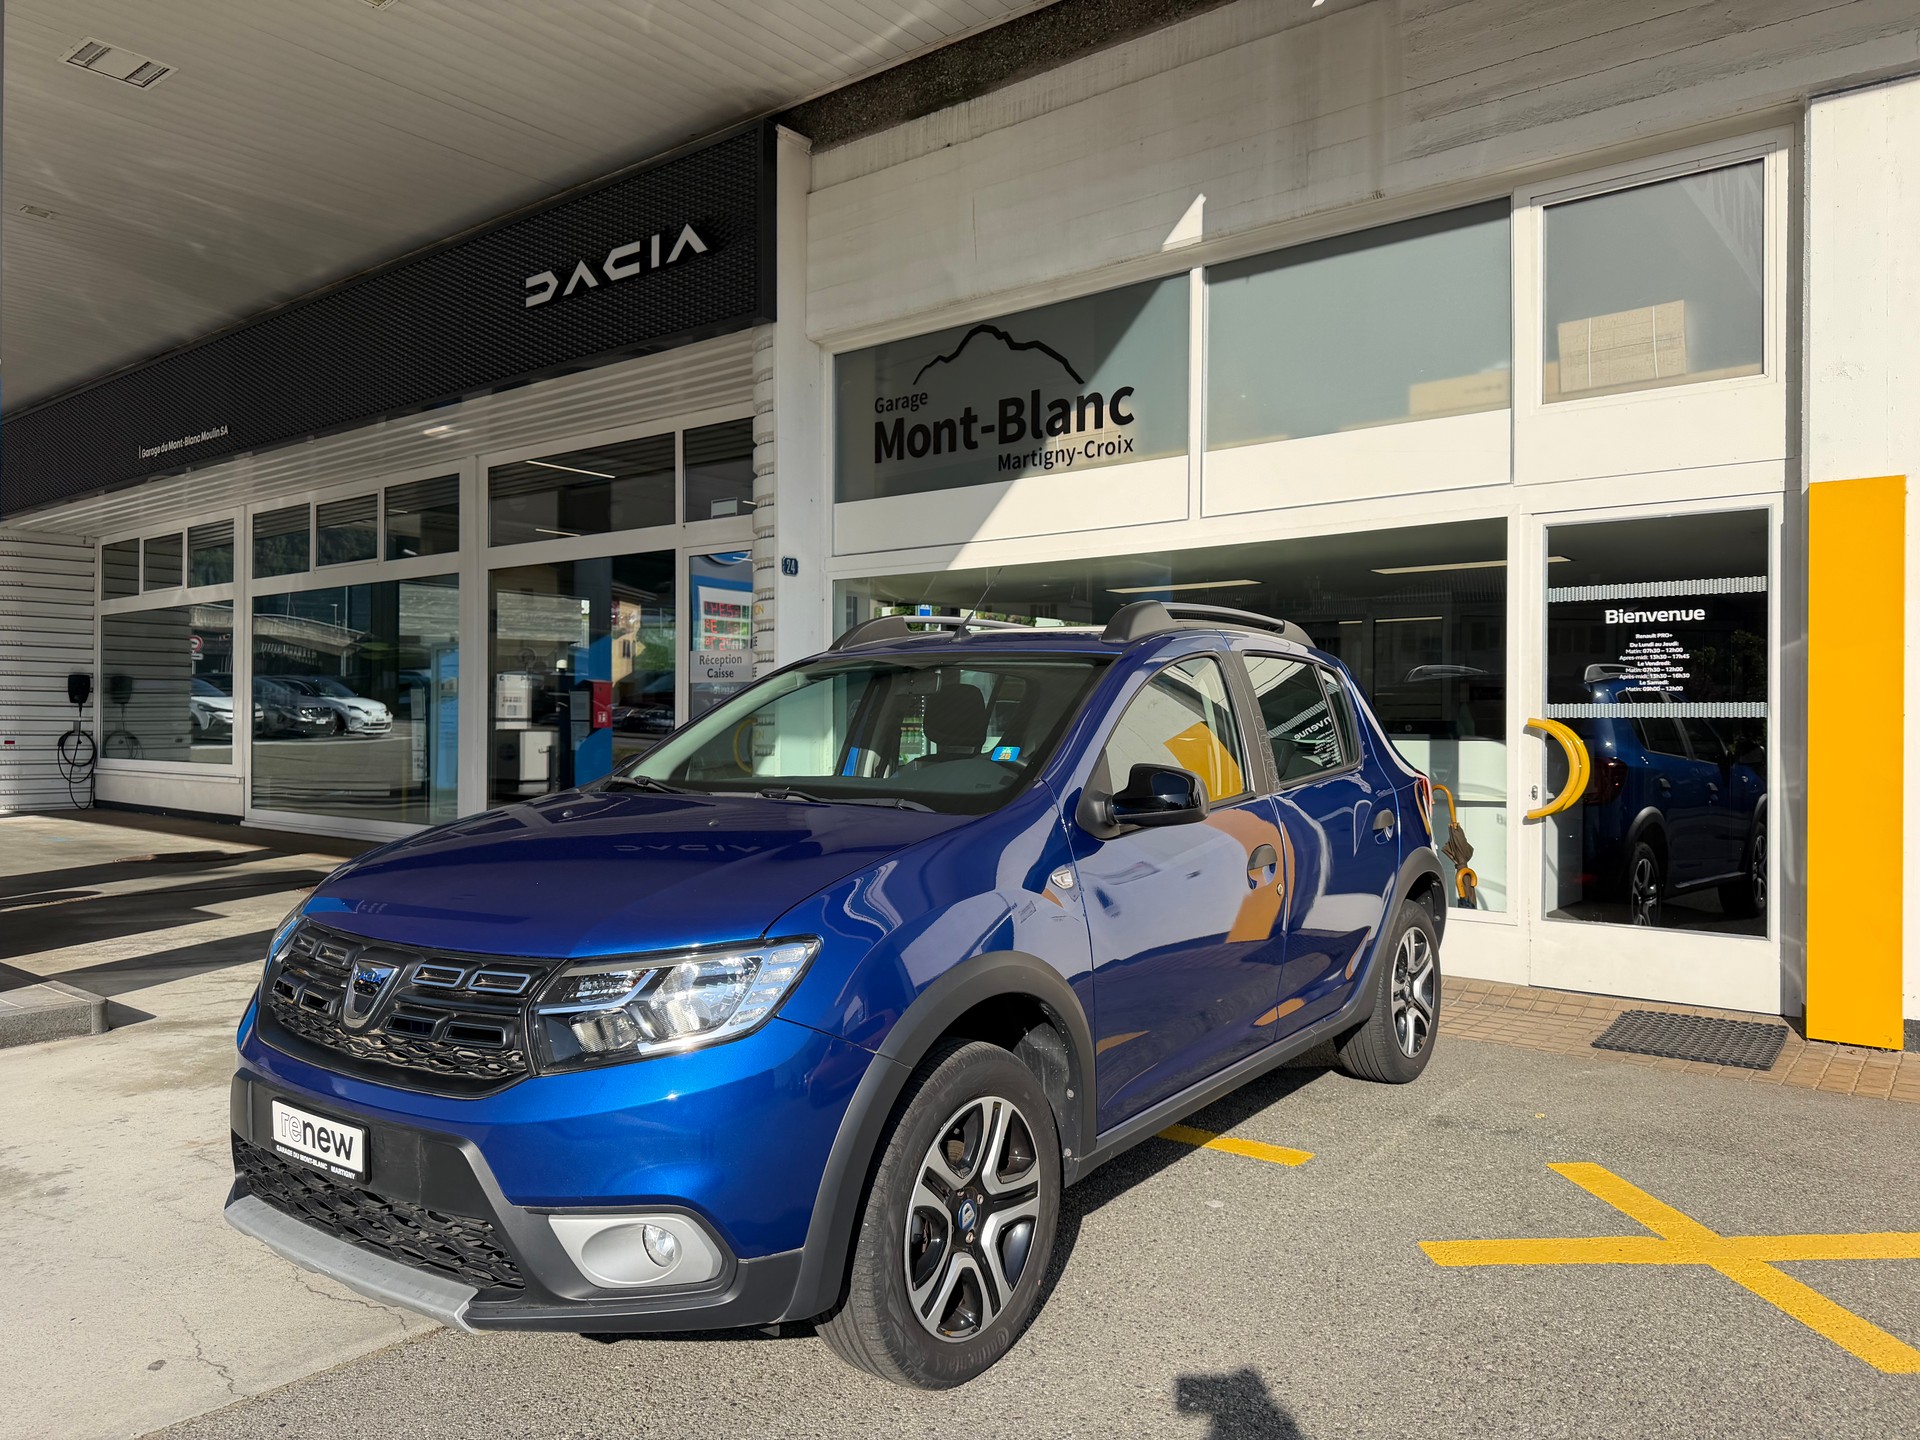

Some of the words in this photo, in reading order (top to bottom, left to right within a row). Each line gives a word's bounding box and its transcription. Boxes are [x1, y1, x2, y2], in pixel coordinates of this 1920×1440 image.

[525, 223, 708, 308] DACIA
[874, 390, 928, 414] Garage
[142, 446, 161, 458] Garage
[161, 442, 168, 453] du
[168, 435, 201, 450] Mont-Blanc
[201, 427, 220, 441] Moulin
[220, 425, 229, 436] SA
[874, 386, 1135, 464] Mont-Blanc
[998, 435, 1134, 472] Martigny-Croix
[786, 559, 795, 574] 24
[1604, 608, 1706, 624] Bienvenue
[699, 653, 742, 668] Réception
[707, 667, 734, 679] Caisse
[281, 1112, 354, 1161] renew
[276, 1145, 293, 1157] GARAGE
[293, 1152, 300, 1160] DU
[300, 1154, 328, 1170] MONT-BLANC
[330, 1165, 356, 1180] MARTIGNY
